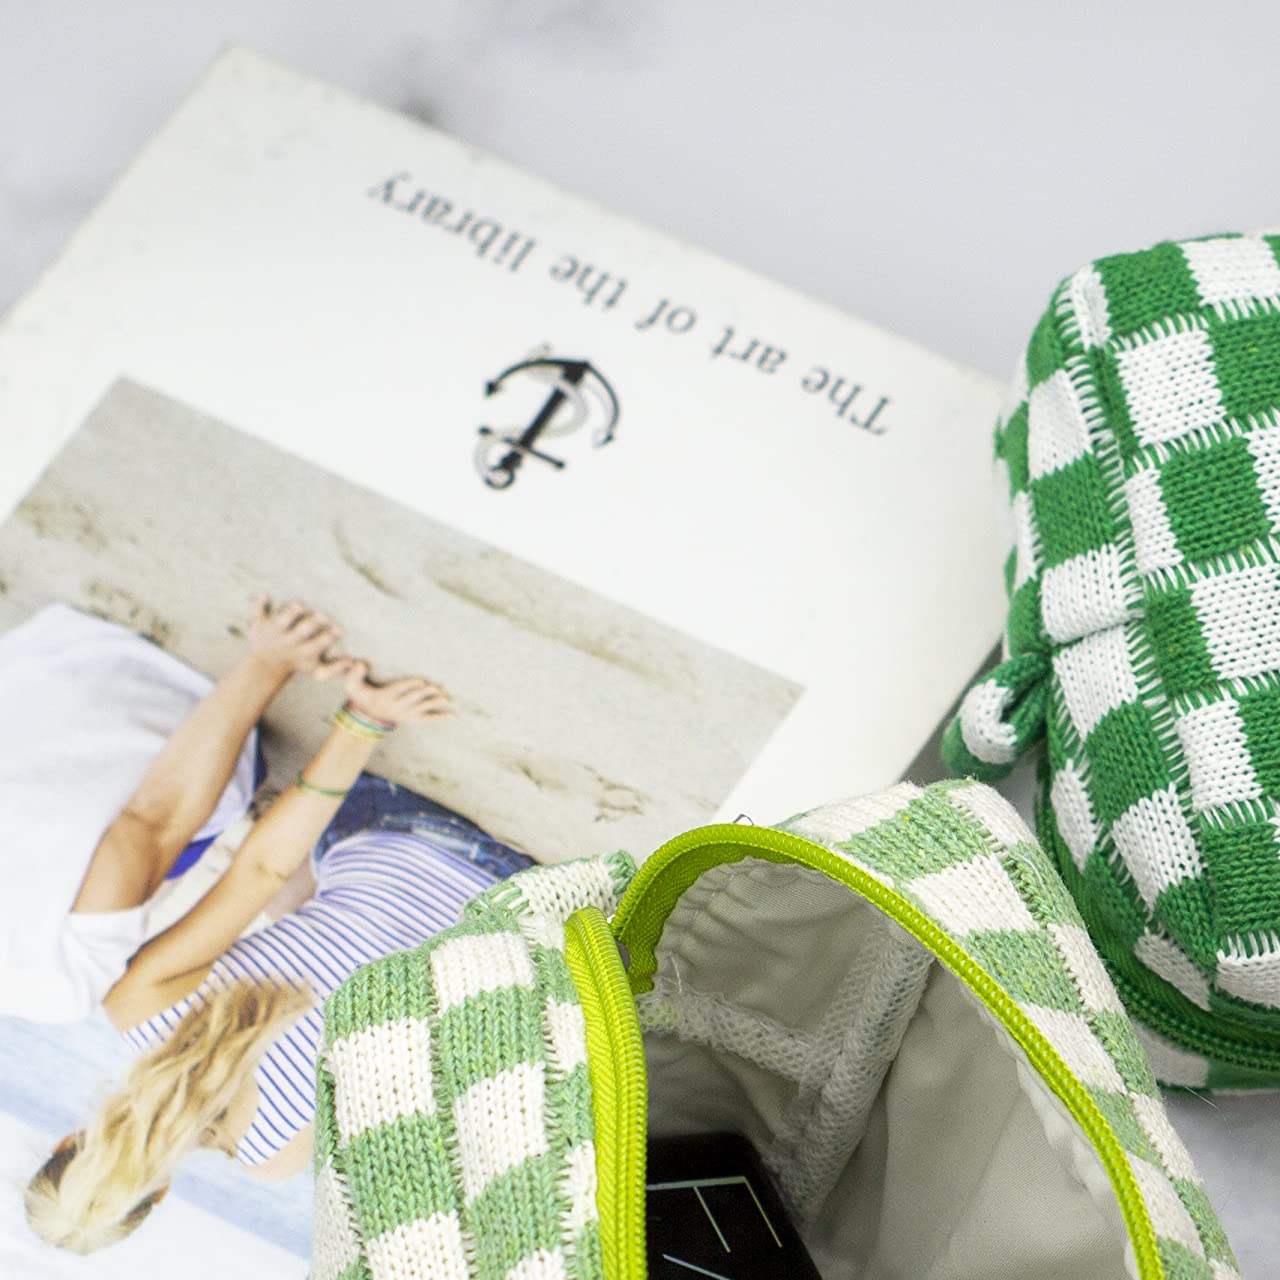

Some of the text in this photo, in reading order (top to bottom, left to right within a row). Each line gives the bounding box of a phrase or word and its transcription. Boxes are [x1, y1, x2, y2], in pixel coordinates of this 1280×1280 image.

[367, 172, 892, 436] The art of the library
